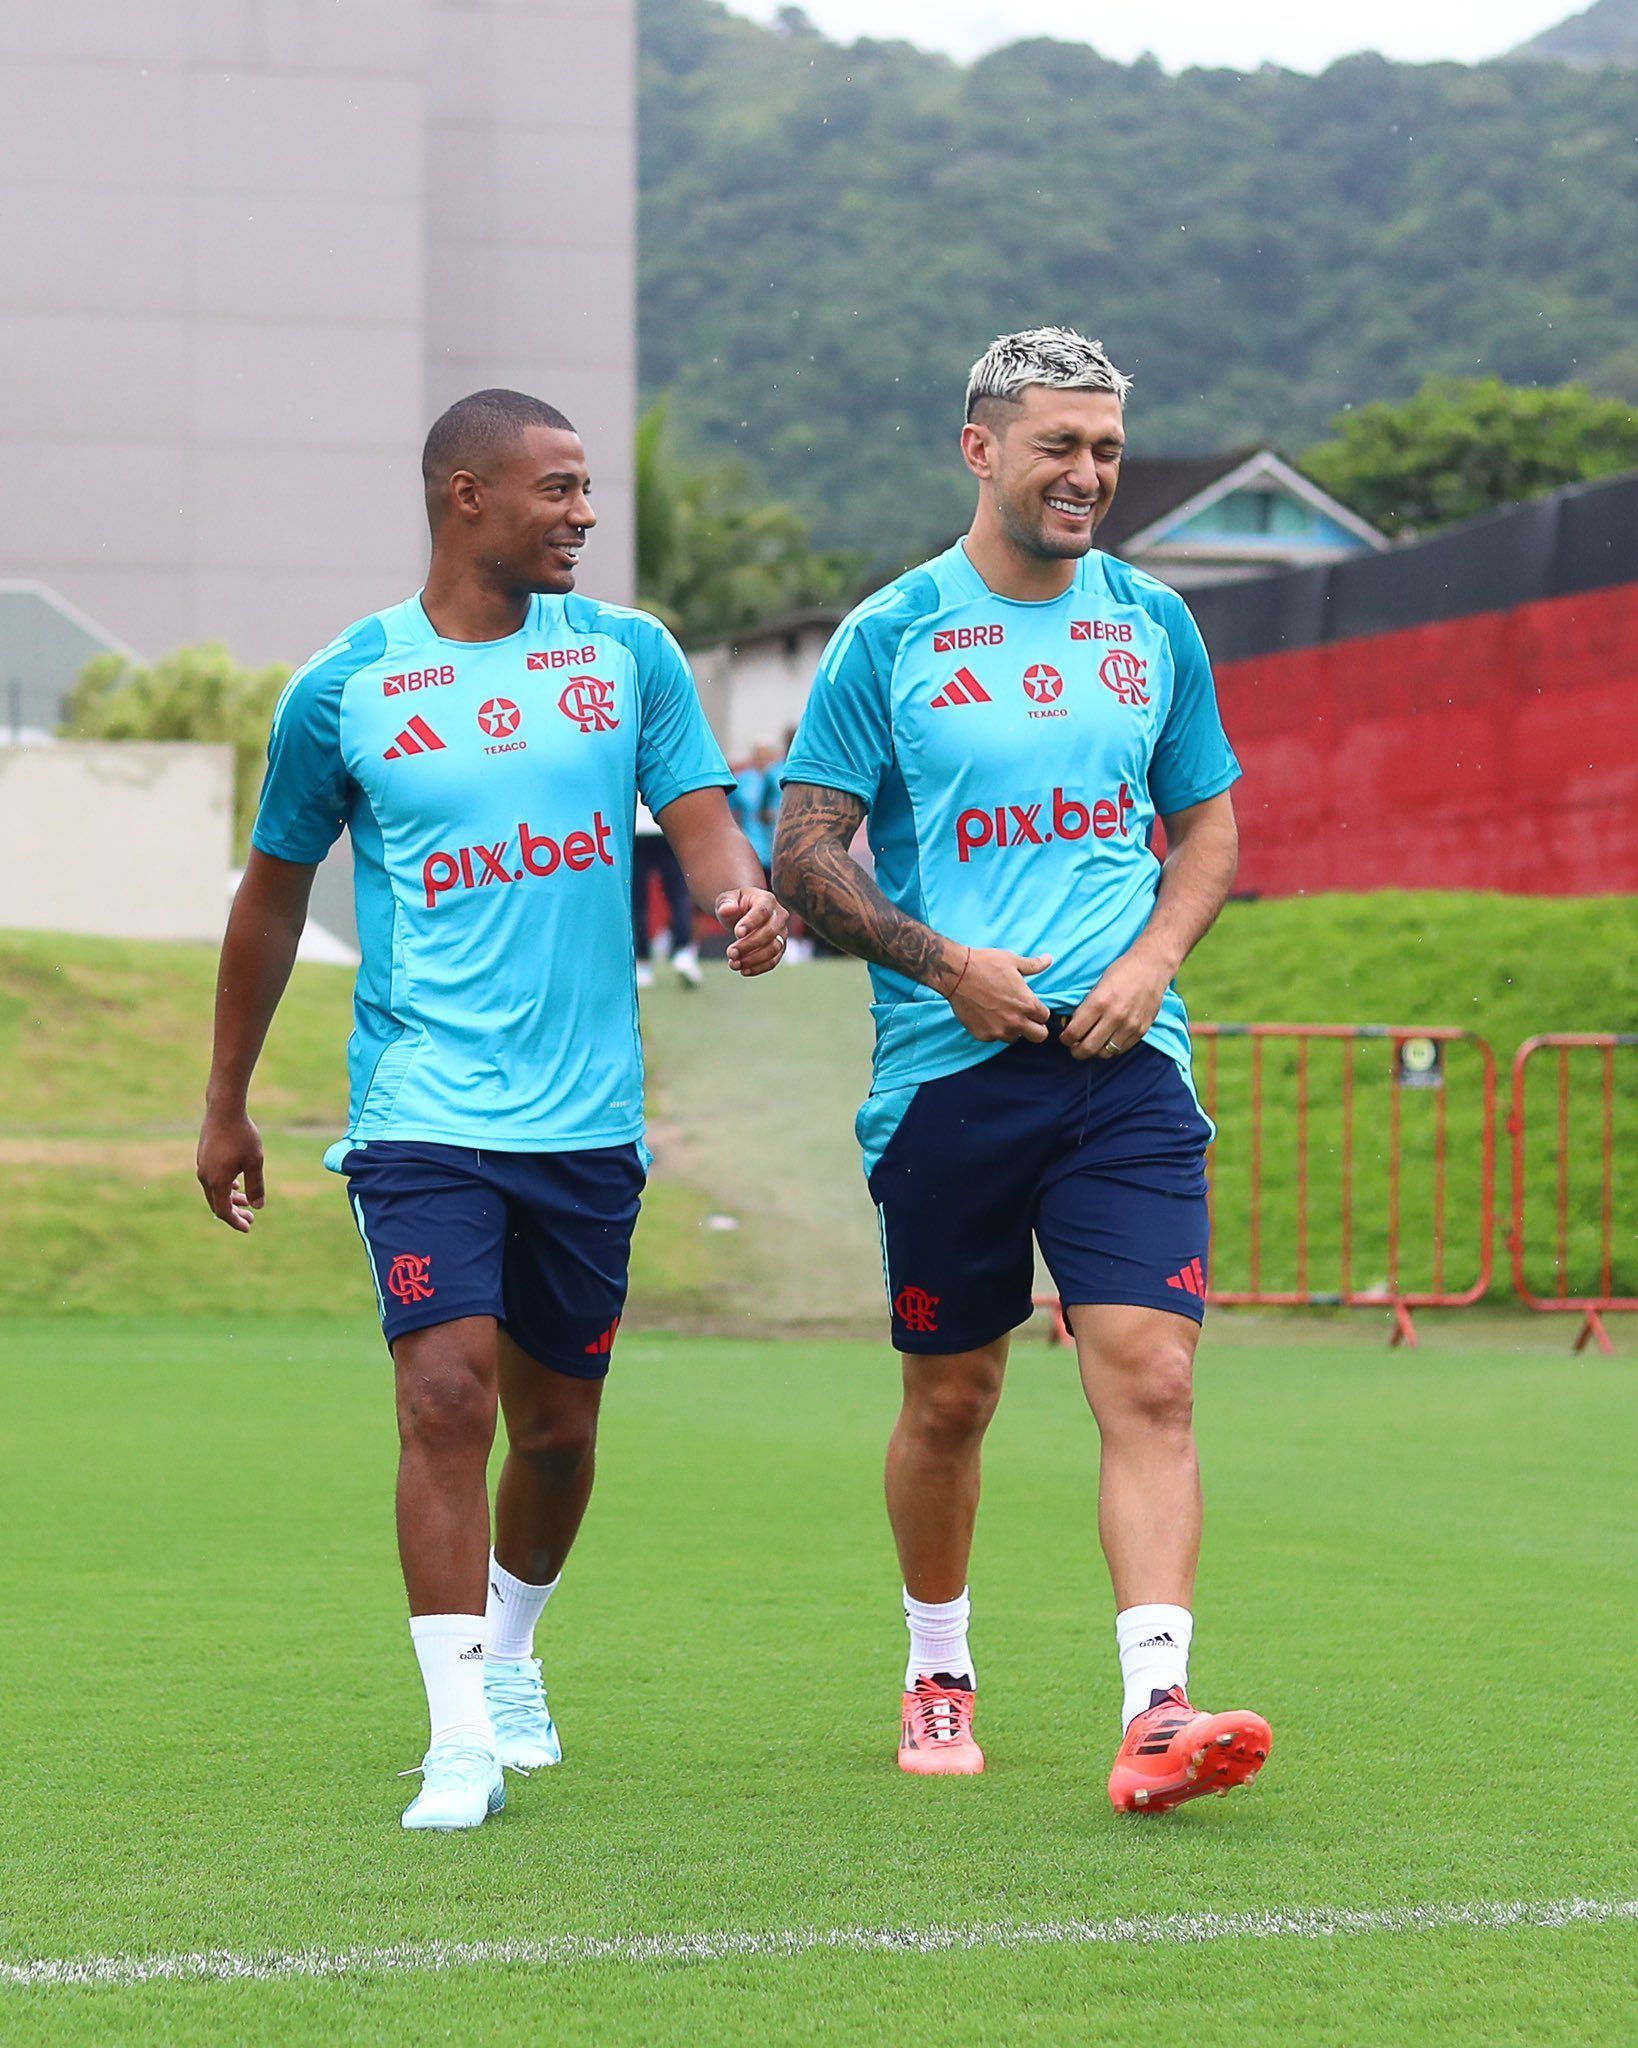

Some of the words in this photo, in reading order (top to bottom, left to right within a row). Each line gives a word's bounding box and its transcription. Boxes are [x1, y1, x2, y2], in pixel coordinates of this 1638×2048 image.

[958, 624, 1004, 648] BRB
[1094, 620, 1133, 642] BRB
[551, 645, 597, 668] BRB
[408, 665, 456, 691] BRB
[1027, 708, 1068, 719] TEXACO
[484, 741, 527, 755] TEXACO
[956, 783, 1134, 863] pix.bet
[423, 811, 615, 908] pix.bet
